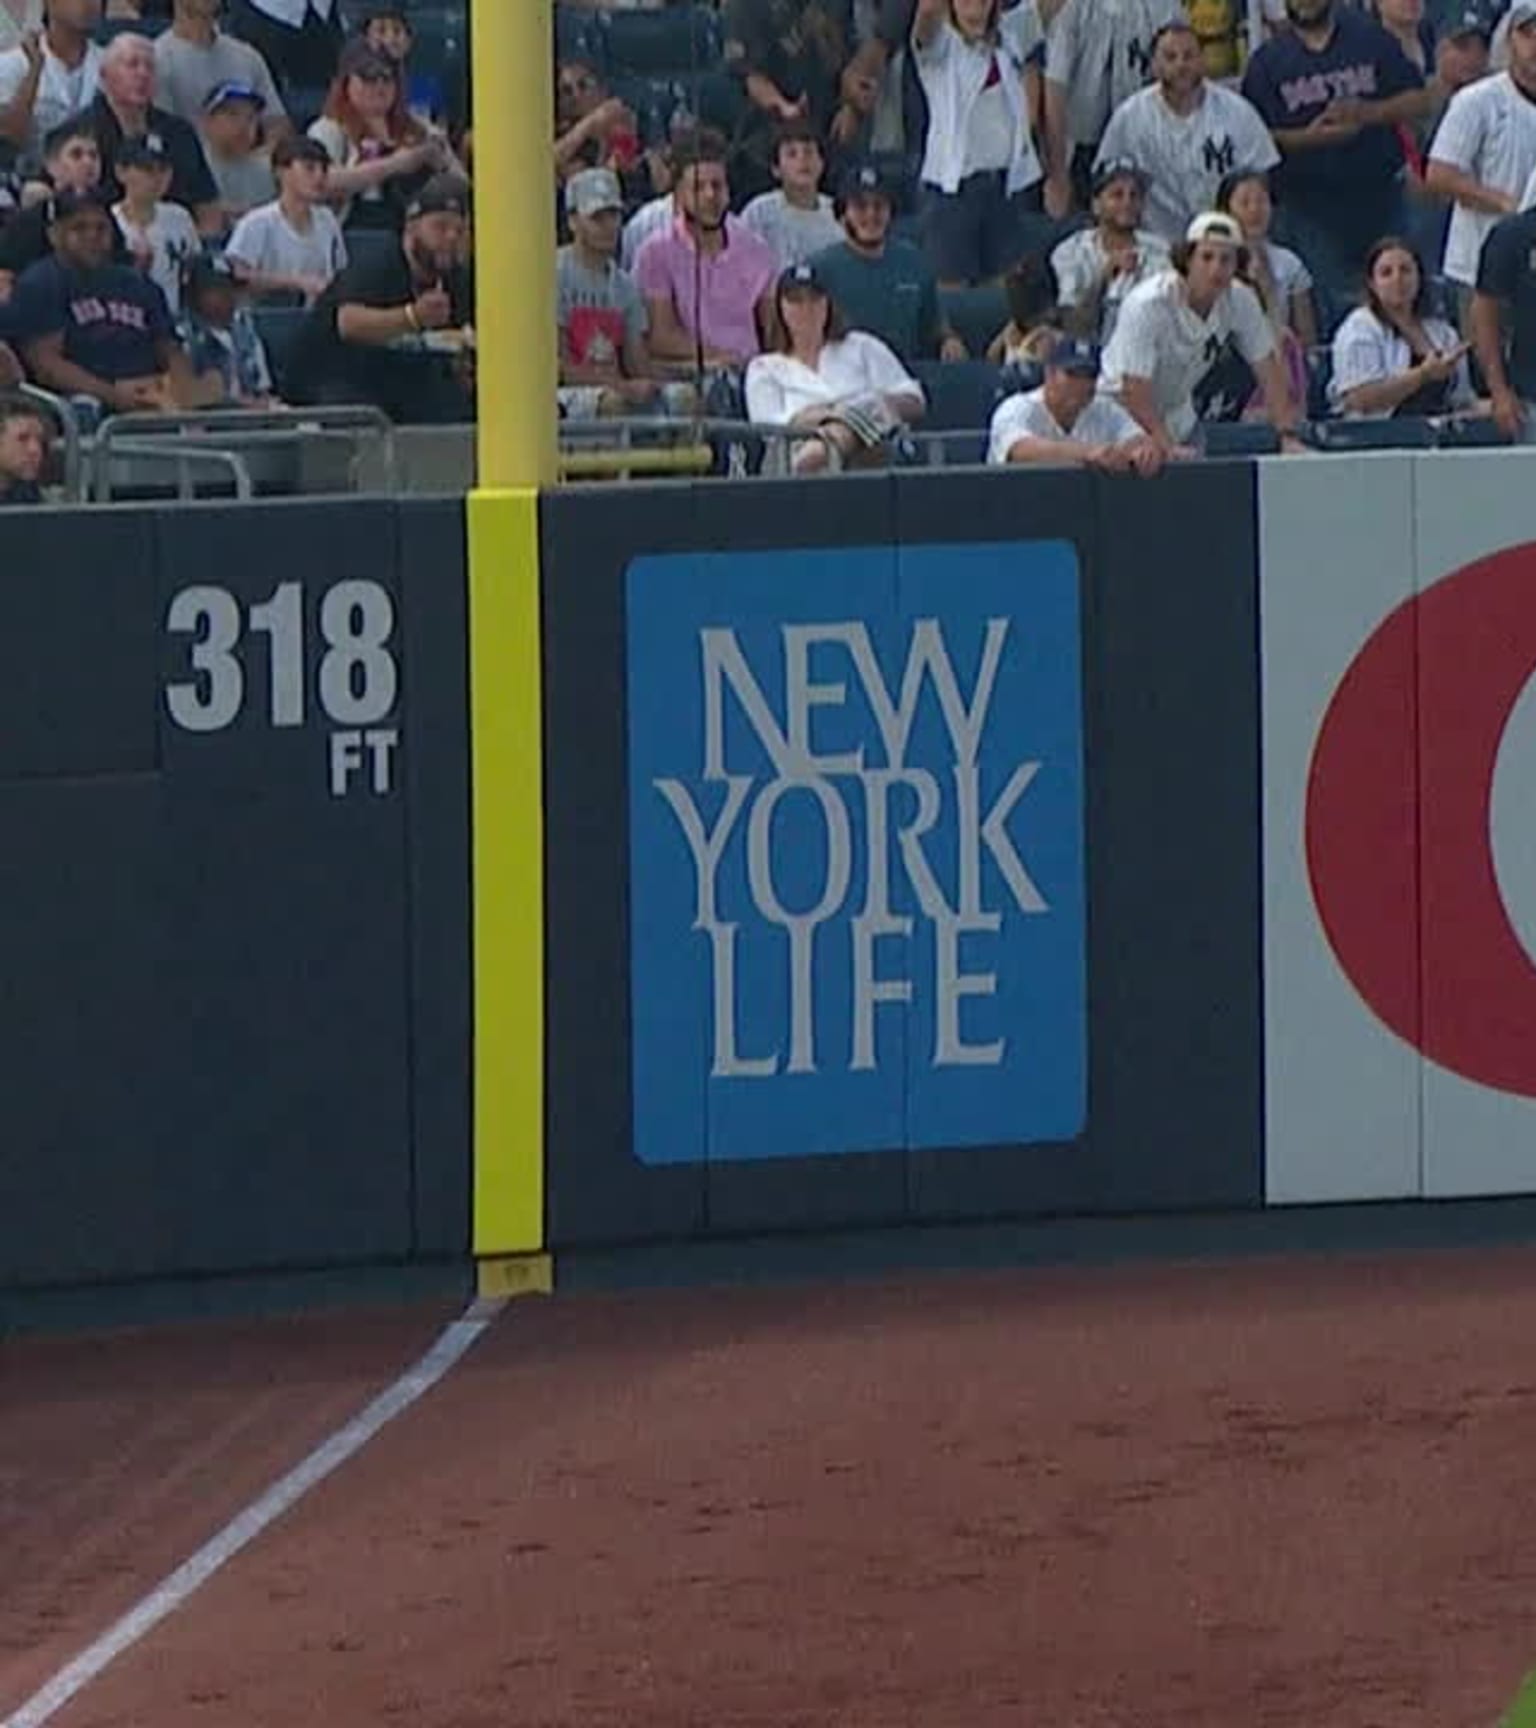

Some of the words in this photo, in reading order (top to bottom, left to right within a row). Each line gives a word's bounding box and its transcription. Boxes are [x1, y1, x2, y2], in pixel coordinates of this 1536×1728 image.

[166, 578, 397, 732] 318
[699, 616, 1010, 781] NEW
[330, 729, 398, 795] FT
[652, 760, 1051, 931] YORK
[700, 914, 1006, 1078] LIFE
